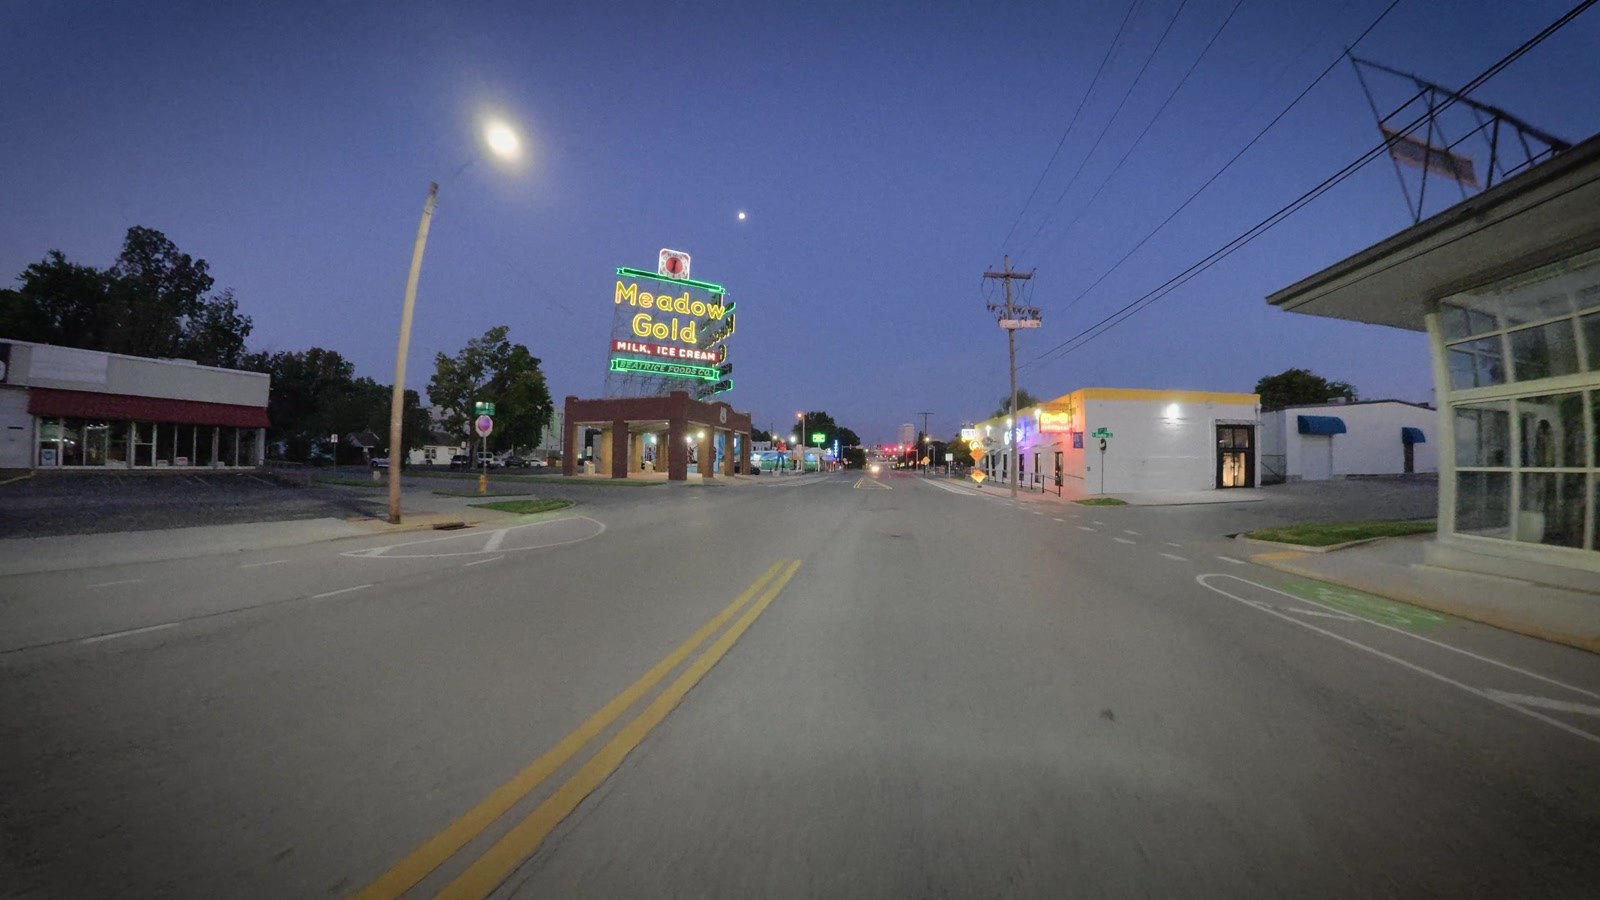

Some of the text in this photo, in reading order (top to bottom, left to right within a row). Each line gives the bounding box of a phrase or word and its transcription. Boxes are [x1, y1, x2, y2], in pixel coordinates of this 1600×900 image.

[615, 281, 725, 320] Meadow
[632, 313, 697, 344] Gold
[617, 341, 651, 354] MILK,
[657, 347, 676, 356] ICE
[679, 349, 715, 360] CREAM
[619, 360, 666, 372] BEATRICE
[667, 365, 697, 375] FOODS
